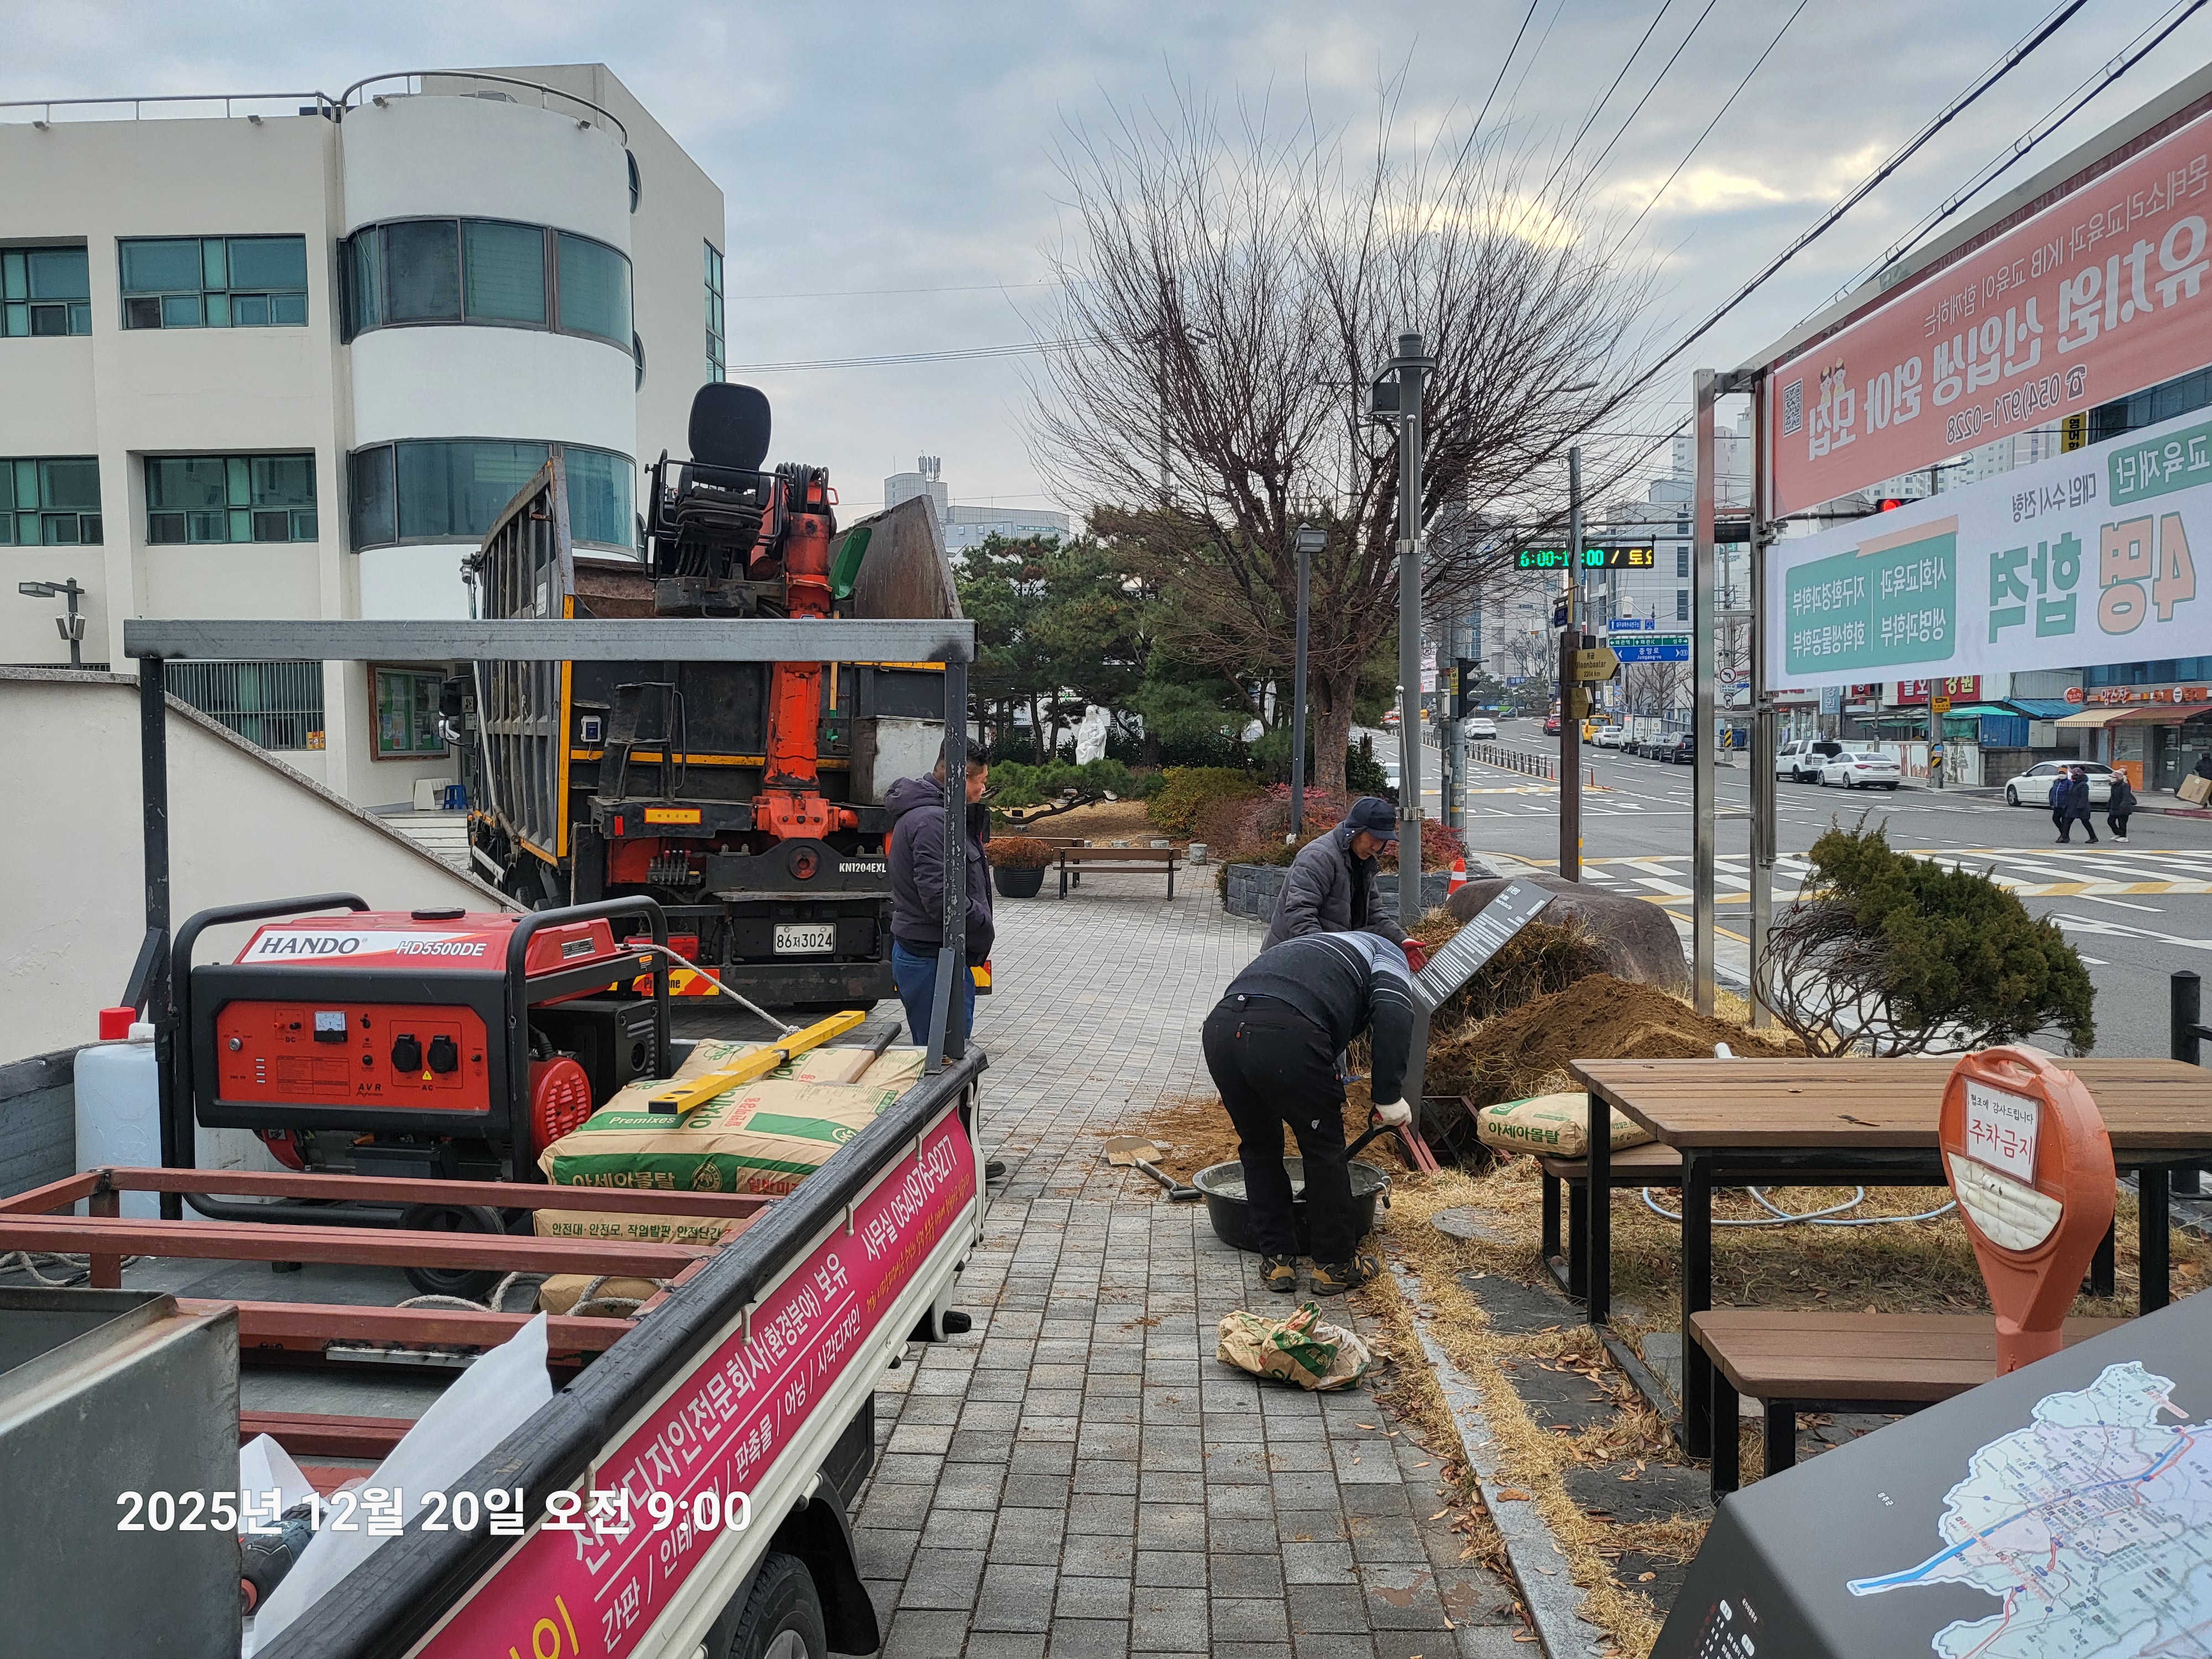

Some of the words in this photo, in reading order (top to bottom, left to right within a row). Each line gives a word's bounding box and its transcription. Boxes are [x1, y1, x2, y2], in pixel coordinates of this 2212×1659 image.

[839, 863, 886, 873] KN1204EXL
[258, 937, 360, 954] HANDO
[395, 941, 487, 957] HD5500DE
[776, 933, 833, 948] 86저3024
[608, 1116, 677, 1125] Premixes
[1970, 1093, 1990, 1112] 협조에
[1992, 1102, 2034, 1125] 감사드립니다
[1488, 1121, 1560, 1145] 아세아몰탈
[1968, 1118, 2034, 1166] 주차금지
[860, 1207, 899, 1261] 사무실
[890, 1134, 957, 1229] 054)976-9277
[813, 1253, 848, 1303] 보유
[602, 1575, 640, 1655] 간판
[735, 1413, 773, 1484] 판촉물
[785, 1370, 806, 1418] 어닝
[817, 1303, 860, 1378] 시각디자인
[1742, 1598, 1758, 1624] 국가지정유산
